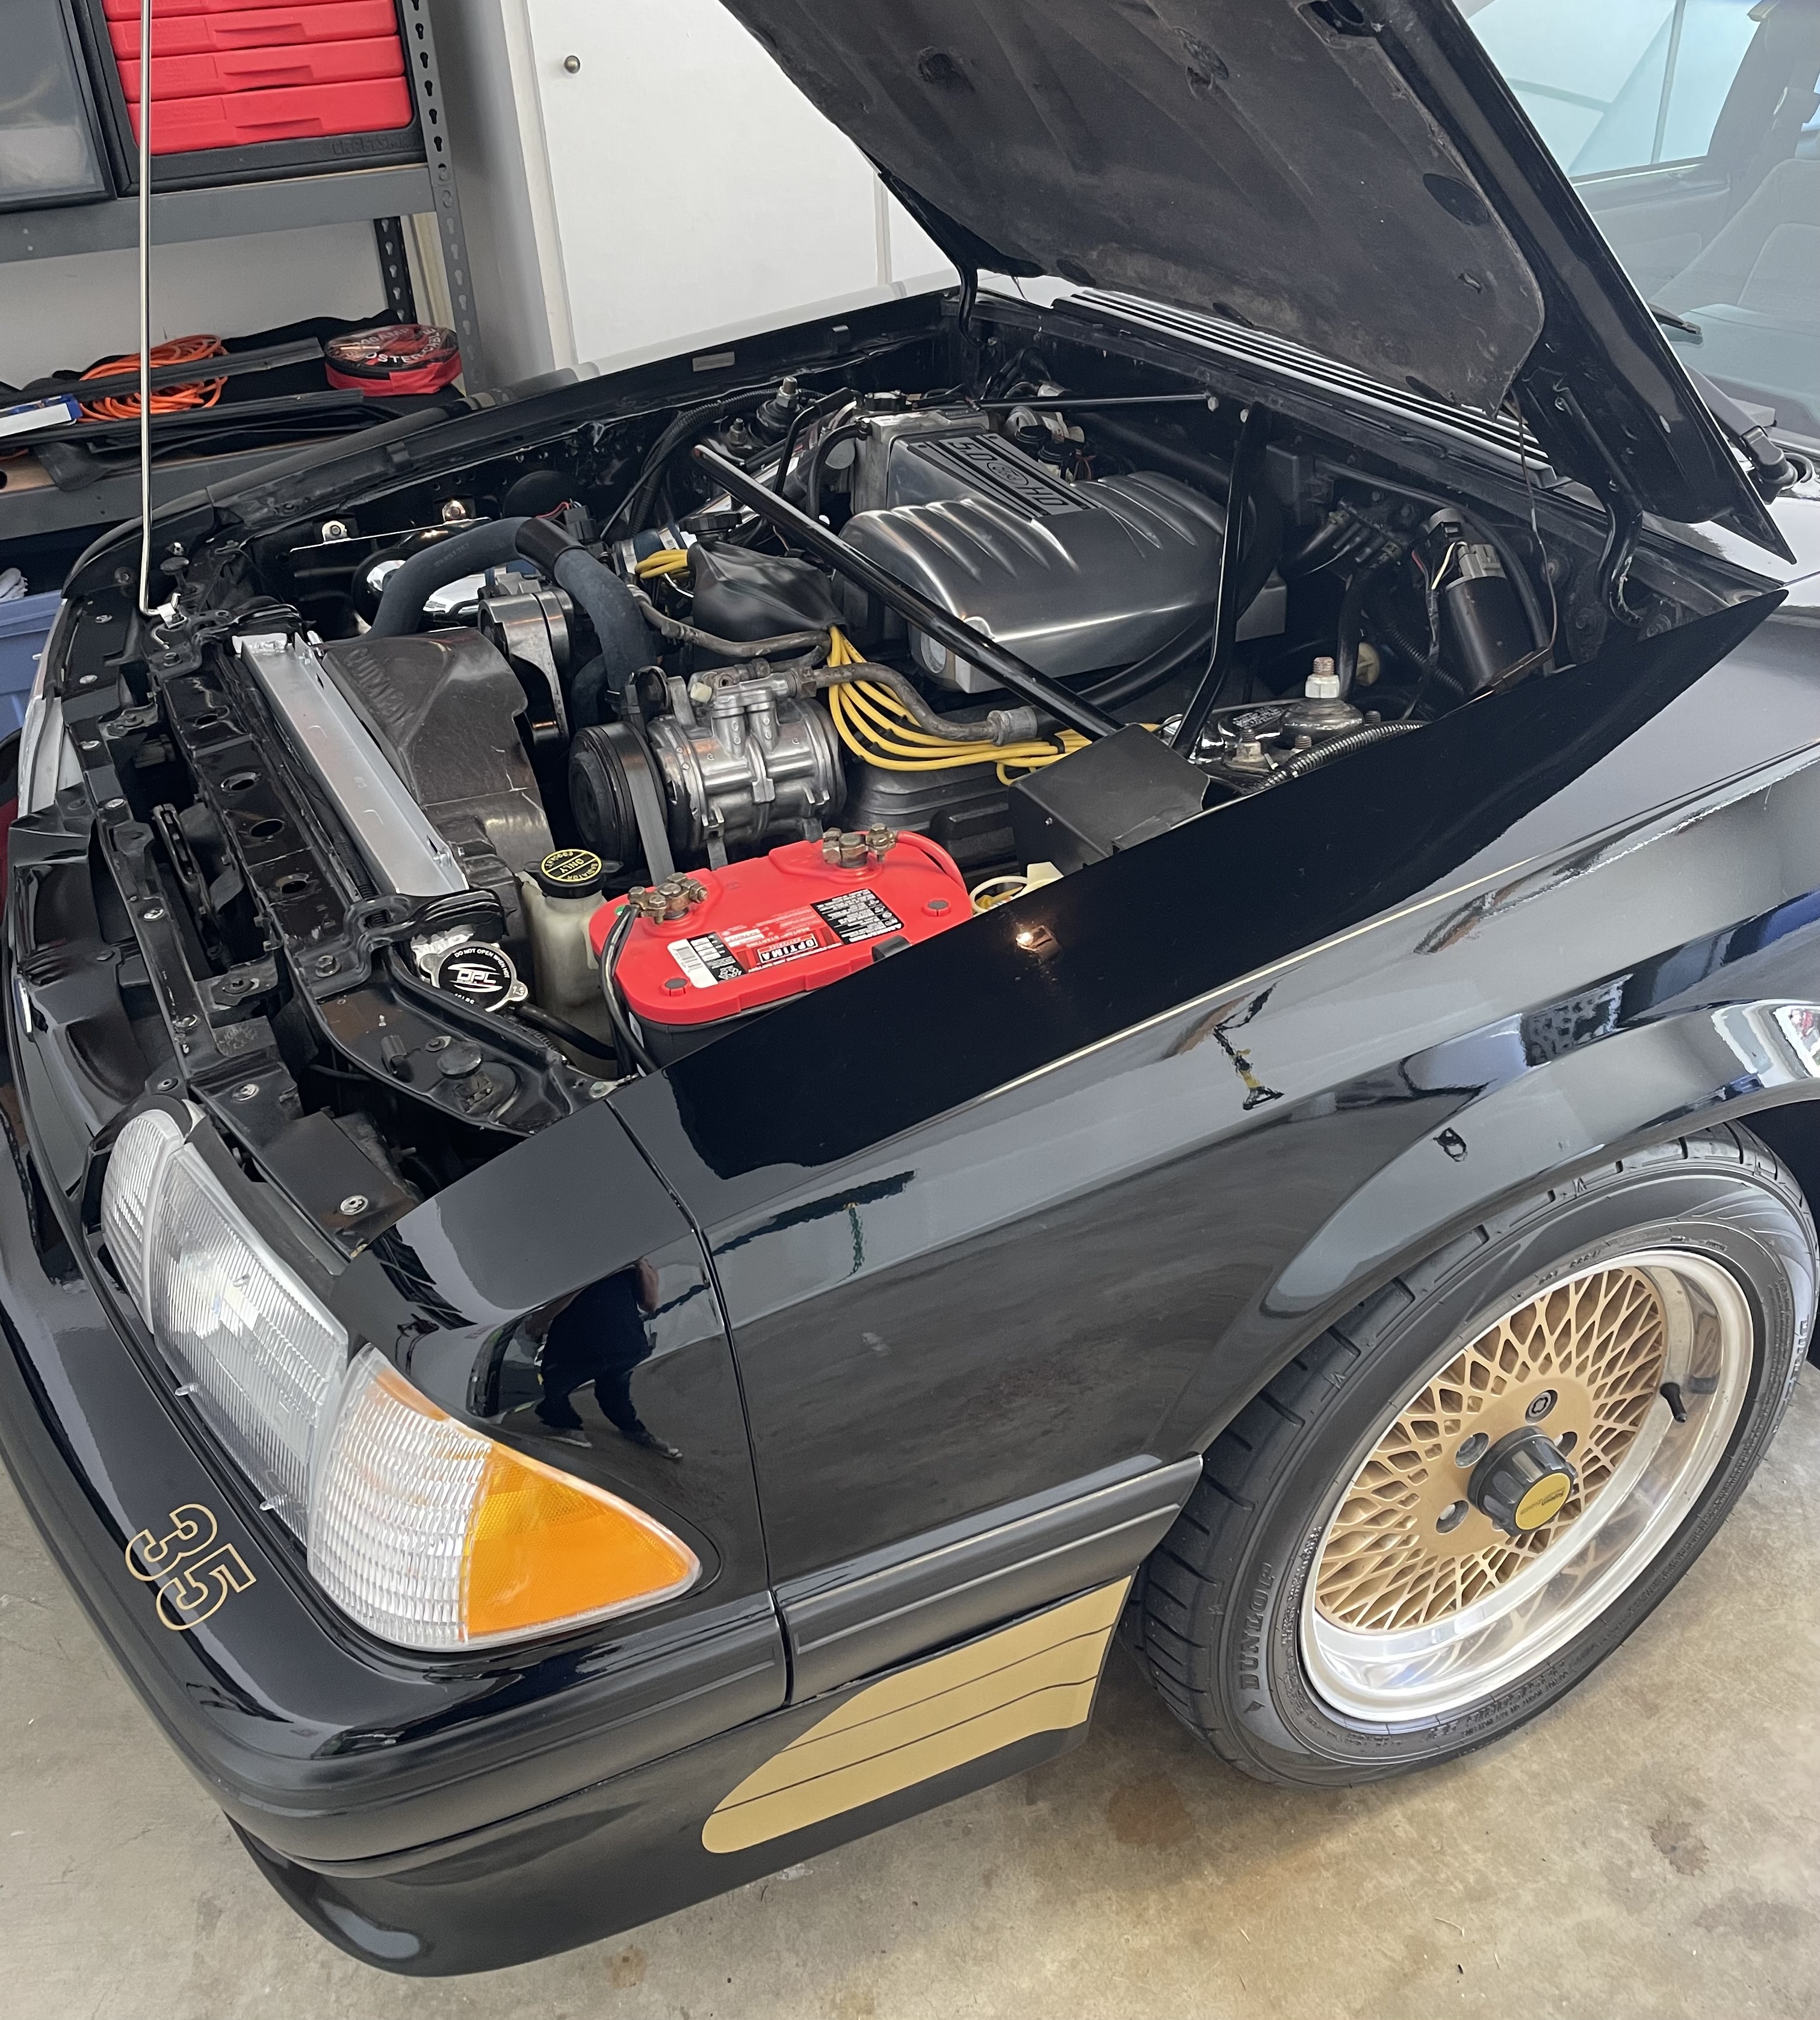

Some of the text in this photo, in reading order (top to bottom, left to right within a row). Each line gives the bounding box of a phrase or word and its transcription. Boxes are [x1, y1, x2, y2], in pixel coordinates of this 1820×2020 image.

[947, 442, 998, 461] 5.0
[559, 858, 584, 873] ONLY
[477, 949, 494, 957] OPEN
[493, 954, 506, 968] WHEN
[761, 938, 815, 961] OPTIMA
[125, 1504, 256, 1631] 35
[1240, 1563, 1275, 1690] DUNLOP
